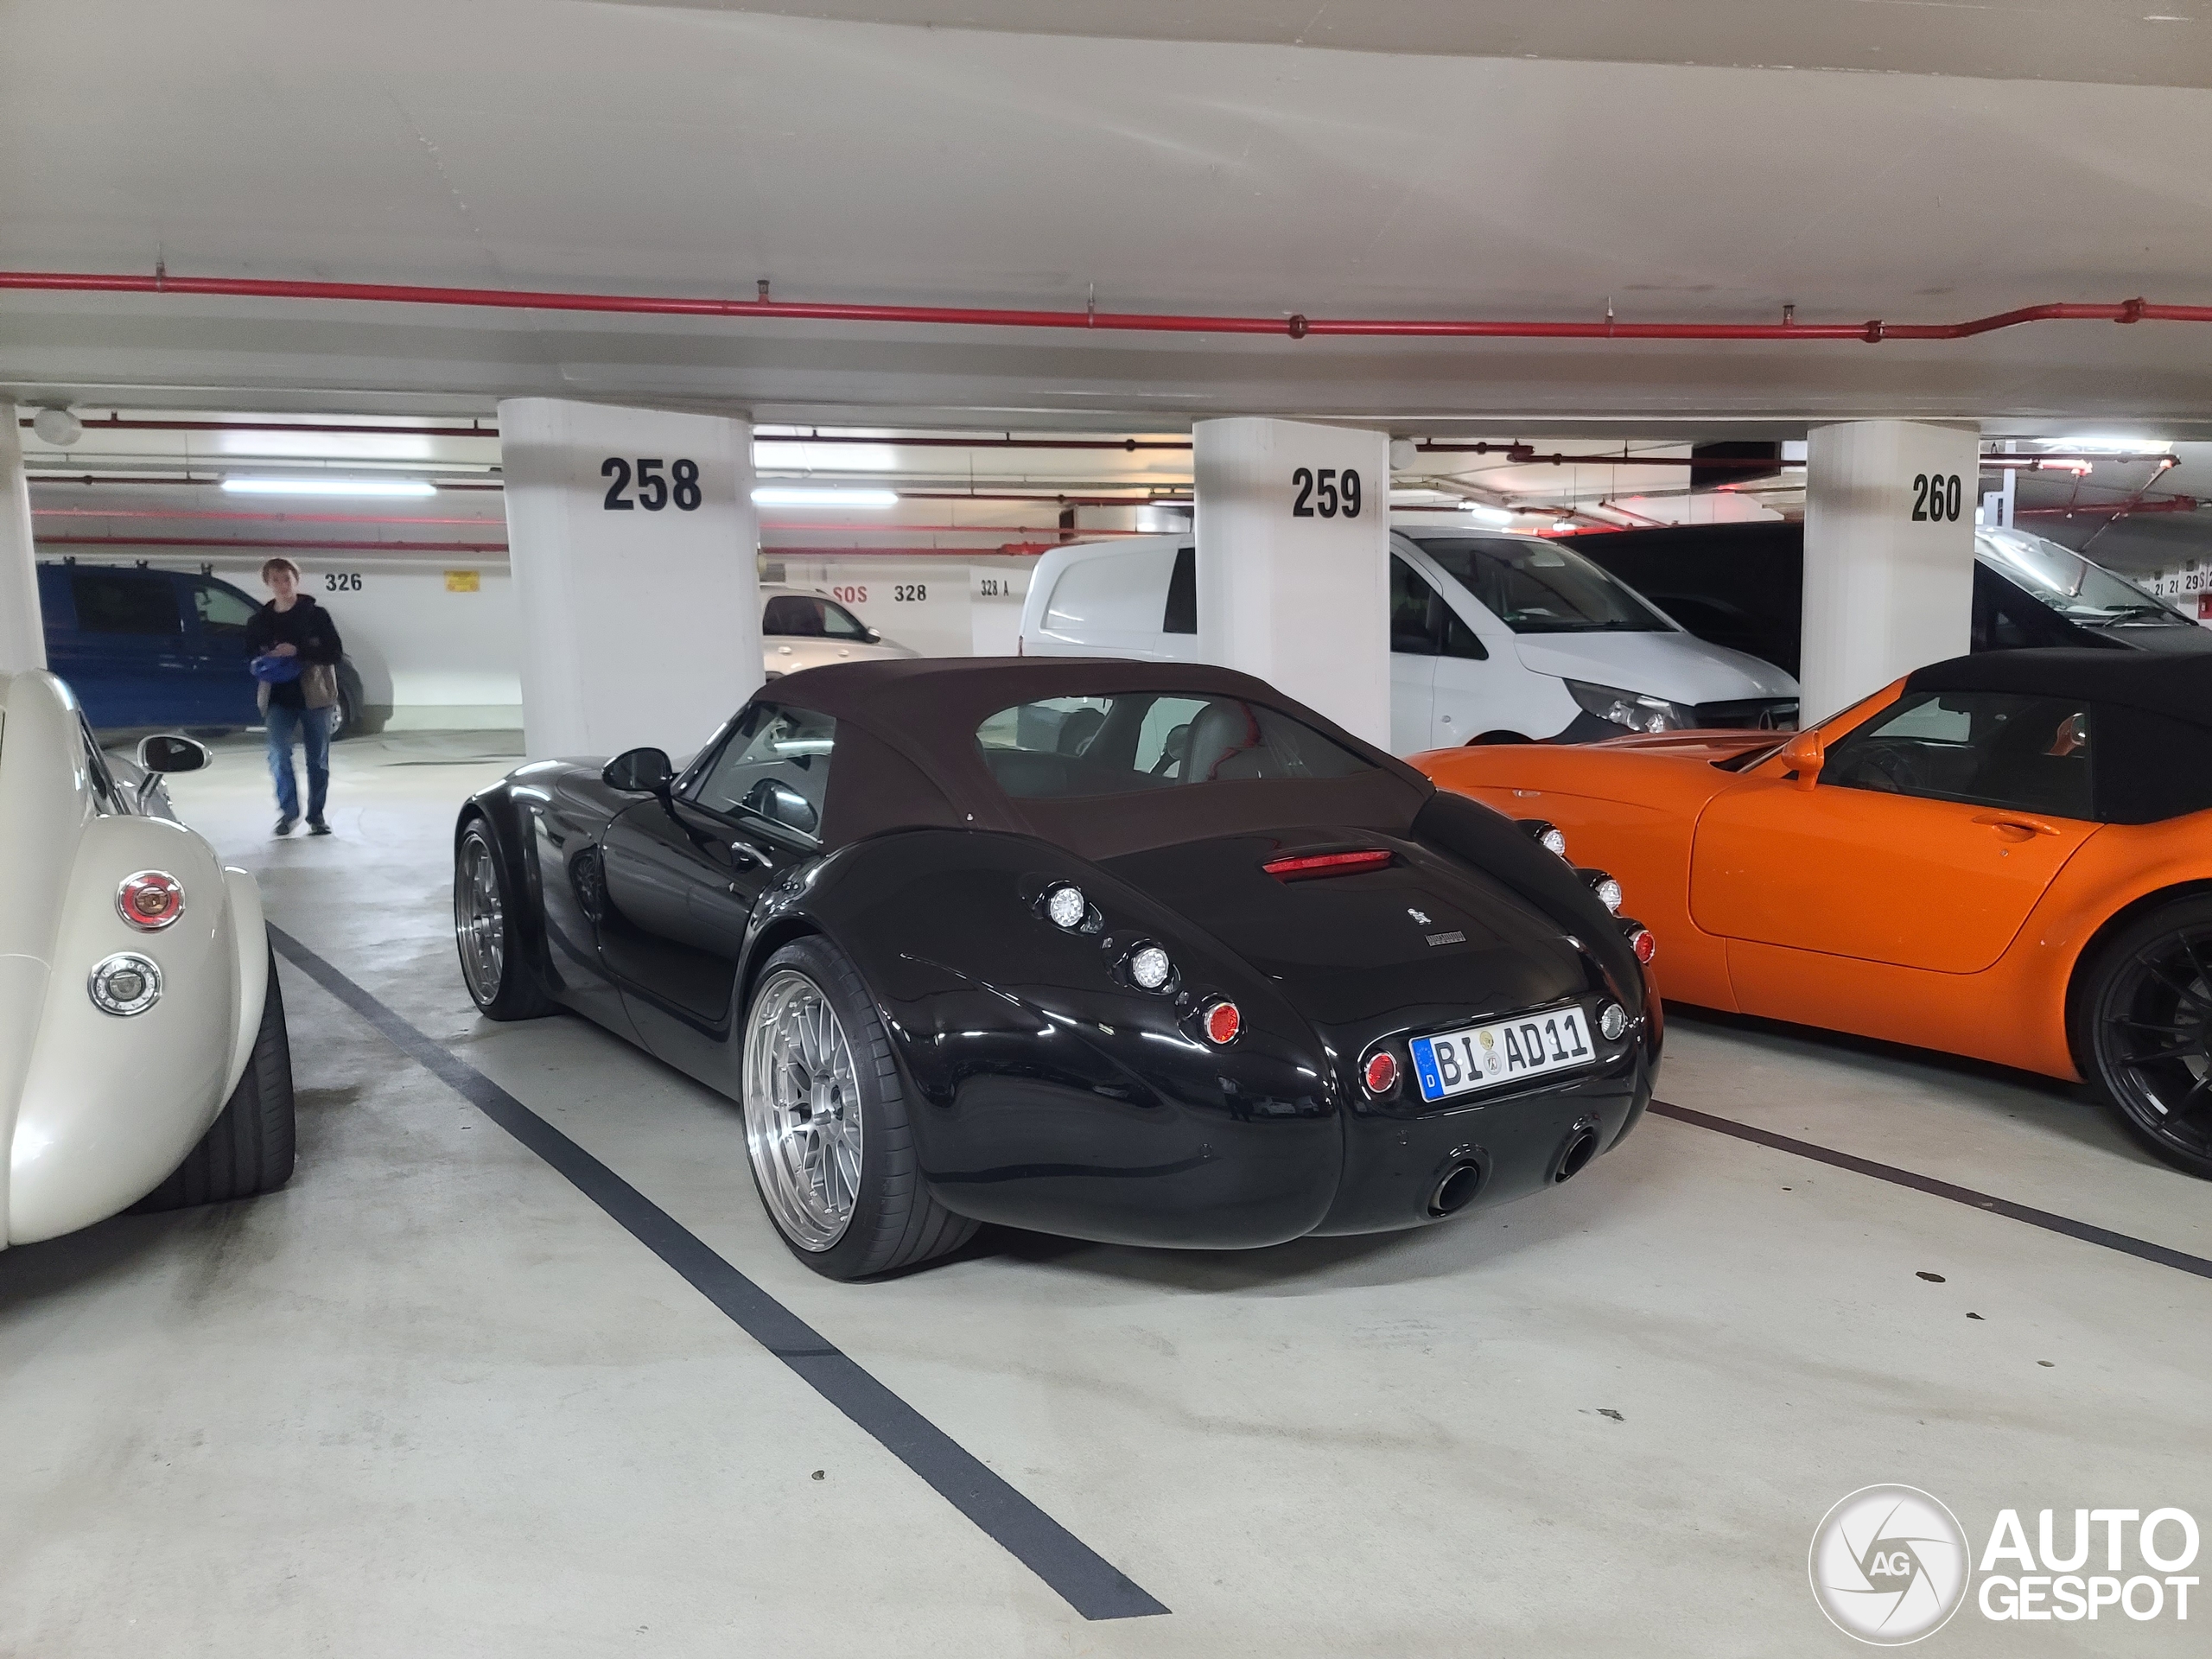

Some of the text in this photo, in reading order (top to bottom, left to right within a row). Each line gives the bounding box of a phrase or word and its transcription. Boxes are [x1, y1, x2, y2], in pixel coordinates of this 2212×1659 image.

[601, 457, 702, 512] 258
[1292, 467, 1361, 518] 259
[1911, 474, 1961, 522] 260
[325, 573, 362, 591] 326
[981, 580, 1009, 596] 328 A
[832, 586, 868, 603] SOS
[893, 584, 927, 601] 328
[1434, 1014, 1588, 1087] BI AD11
[1426, 1074, 1435, 1088] D
